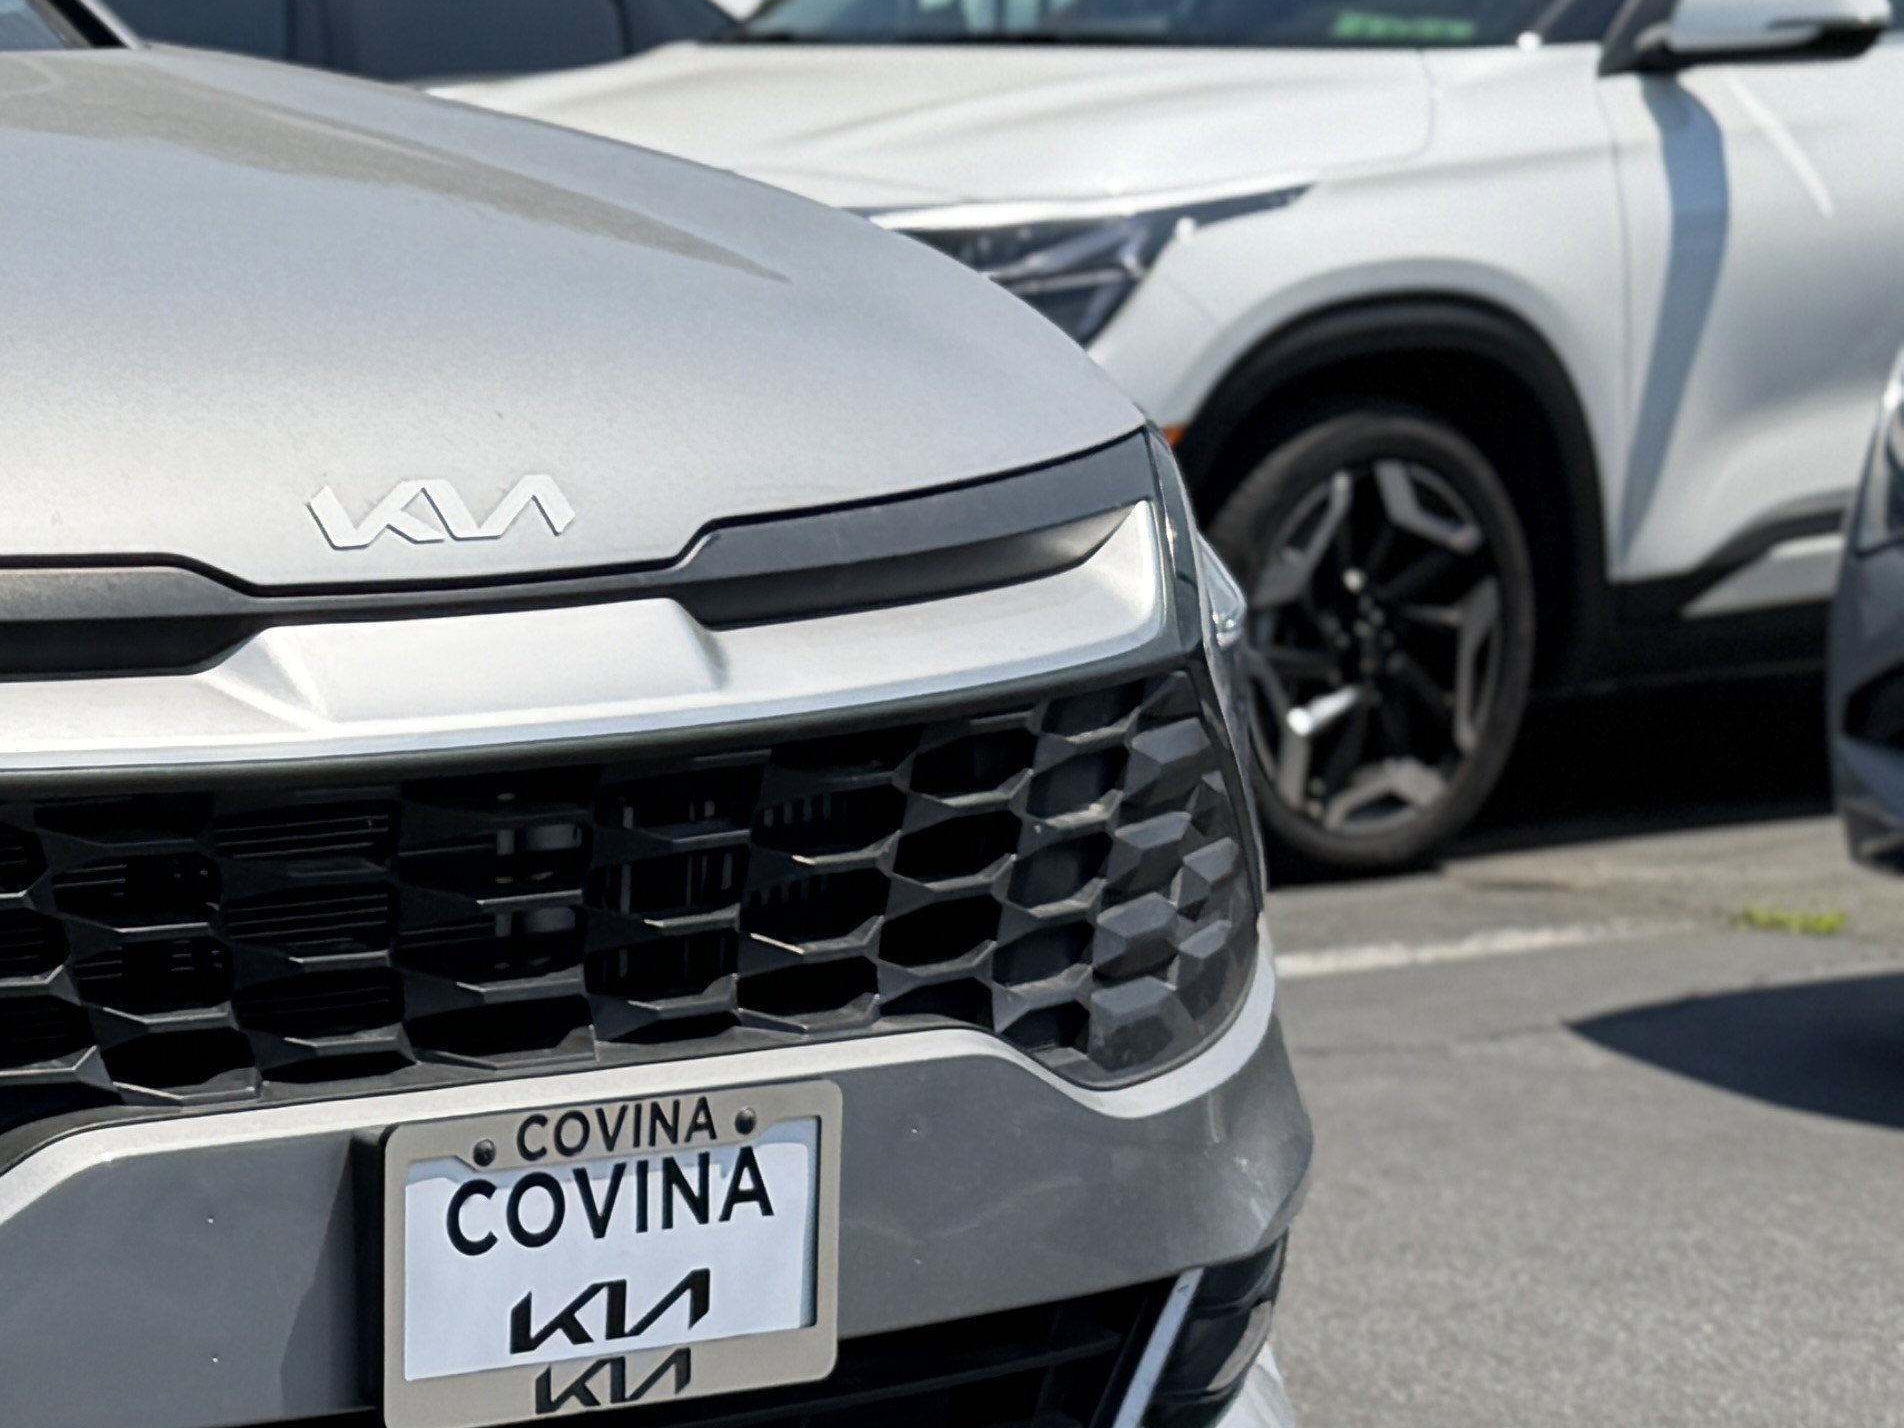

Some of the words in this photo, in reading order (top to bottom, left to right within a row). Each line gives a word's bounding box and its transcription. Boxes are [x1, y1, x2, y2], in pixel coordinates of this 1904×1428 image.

[516, 1096, 718, 1161] COVINA
[446, 1146, 774, 1257] COVINA
[510, 1268, 710, 1355] KIA
[535, 1347, 691, 1415] KIA
